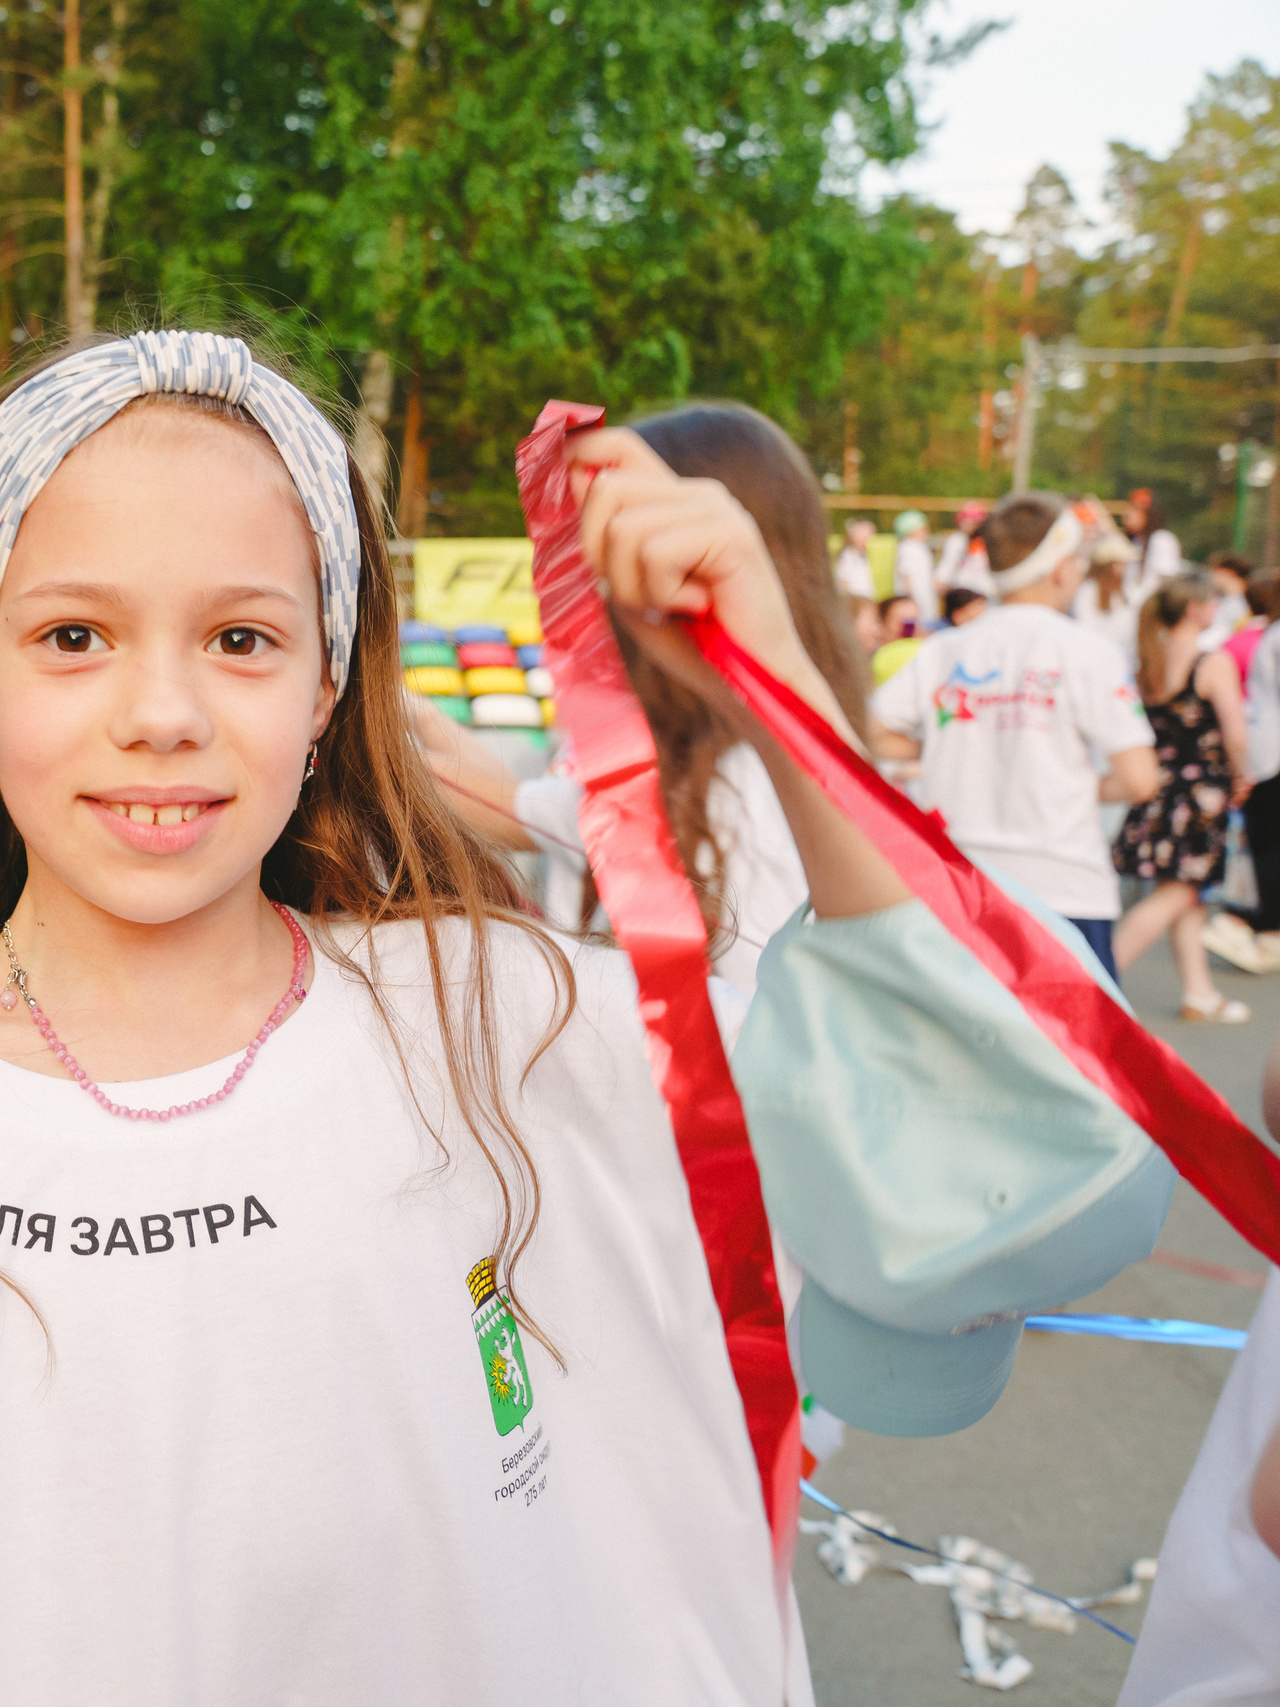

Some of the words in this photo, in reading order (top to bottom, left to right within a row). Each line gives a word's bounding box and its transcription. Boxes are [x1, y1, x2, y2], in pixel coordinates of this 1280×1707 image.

[70, 1194, 277, 1257] ЗАВТРА
[494, 1455, 540, 1502] городской
[524, 1484, 538, 1507] 275
